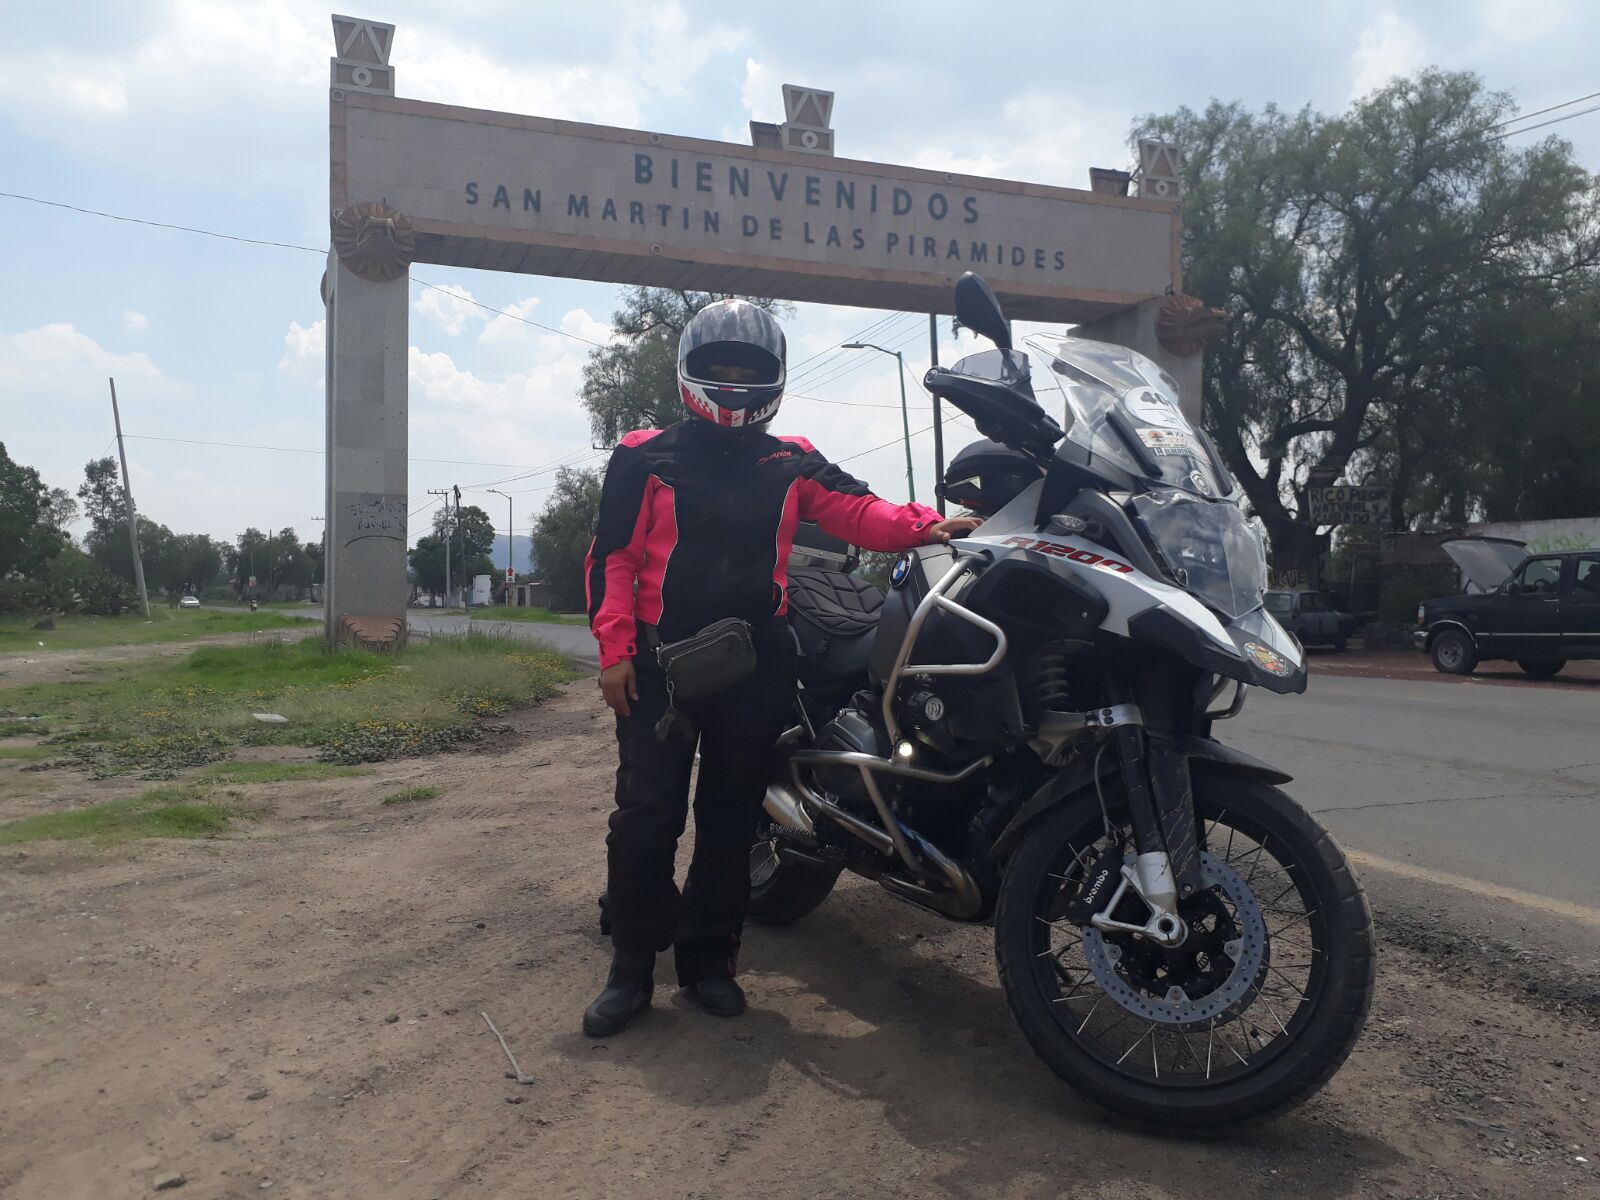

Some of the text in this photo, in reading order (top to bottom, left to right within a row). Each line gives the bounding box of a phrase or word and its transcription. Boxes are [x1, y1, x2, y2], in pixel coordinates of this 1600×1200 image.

[635, 154, 979, 224] BIENVENIDOS
[465, 182, 1065, 270] SAN MARTIN DE LAS PIRAMIDES
[1311, 489, 1345, 502] RICO
[1000, 536, 1135, 574] R1200
[1083, 869, 1109, 904] brembo
